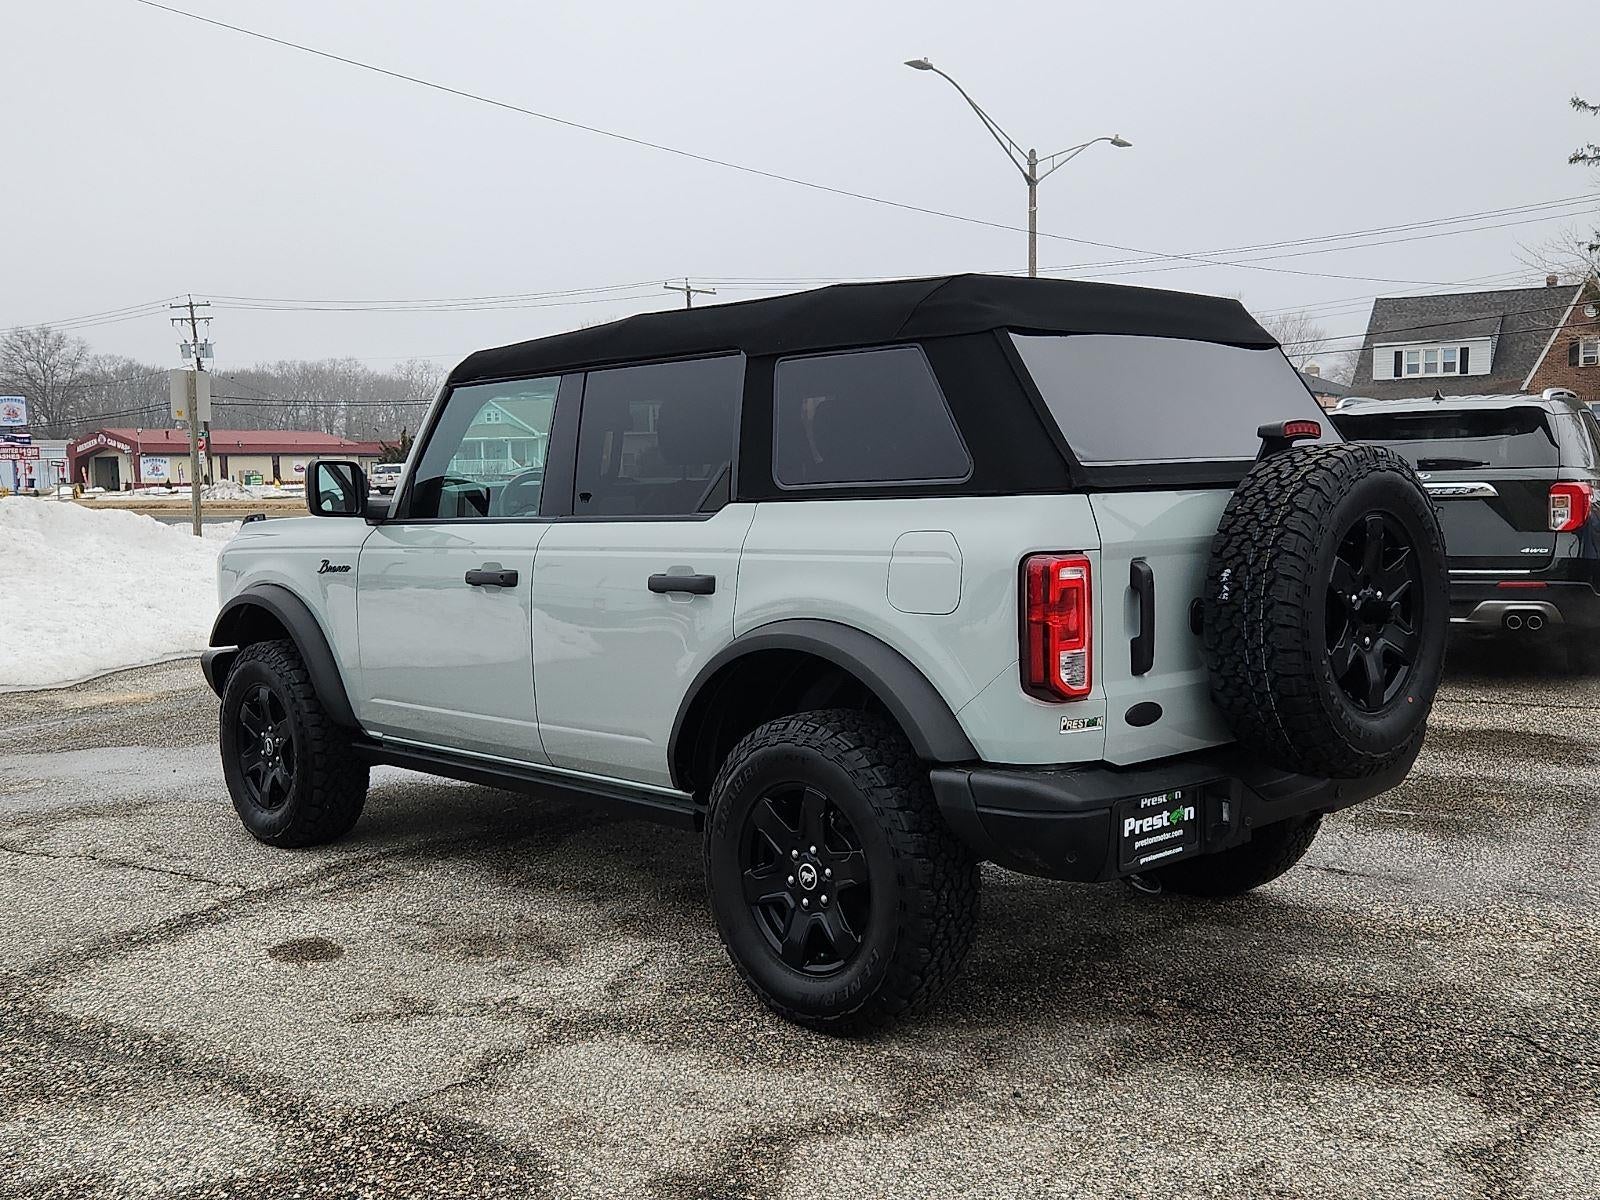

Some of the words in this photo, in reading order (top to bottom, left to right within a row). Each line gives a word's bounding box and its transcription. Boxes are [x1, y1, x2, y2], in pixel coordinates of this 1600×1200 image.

[316, 559, 352, 575] Bronco
[1123, 805, 1195, 838] Preston
[1134, 828, 1184, 851] prestonmotor.com
